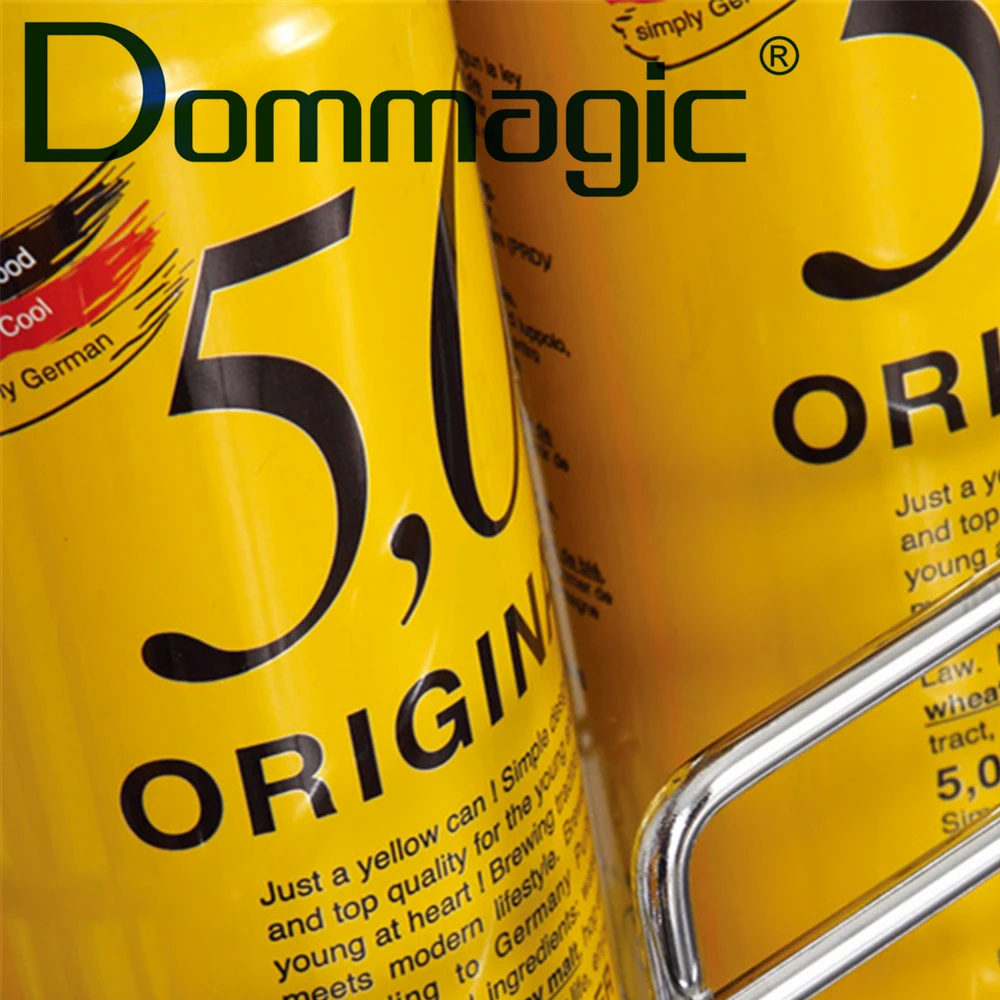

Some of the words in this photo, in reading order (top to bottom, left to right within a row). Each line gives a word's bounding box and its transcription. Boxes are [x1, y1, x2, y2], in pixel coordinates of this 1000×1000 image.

[635, 7, 704, 41] simply
[0, 296, 53, 338] Cool
[20, 332, 115, 390] German
[894, 483, 953, 519] Just
[960, 479, 977, 500] a
[901, 519, 952, 554] and
[960, 507, 1000, 535] top
[904, 549, 987, 592] young
[929, 721, 996, 755] tract,
[259, 867, 324, 908] Just
[331, 865, 351, 888] a
[356, 824, 440, 884] yellow
[446, 794, 488, 834] can
[501, 734, 551, 794] Simple
[267, 906, 326, 943] and
[333, 891, 379, 926] top
[386, 846, 467, 906] quality
[473, 820, 502, 857] for
[504, 801, 533, 833] the
[273, 935, 366, 984] young
[374, 922, 401, 948] at
[407, 881, 473, 934] heart
[491, 808, 556, 885] Brewing
[389, 915, 485, 981] modern
[492, 849, 561, 922] lifestyle.
[455, 957, 480, 984] to
[493, 868, 573, 958] Germany
